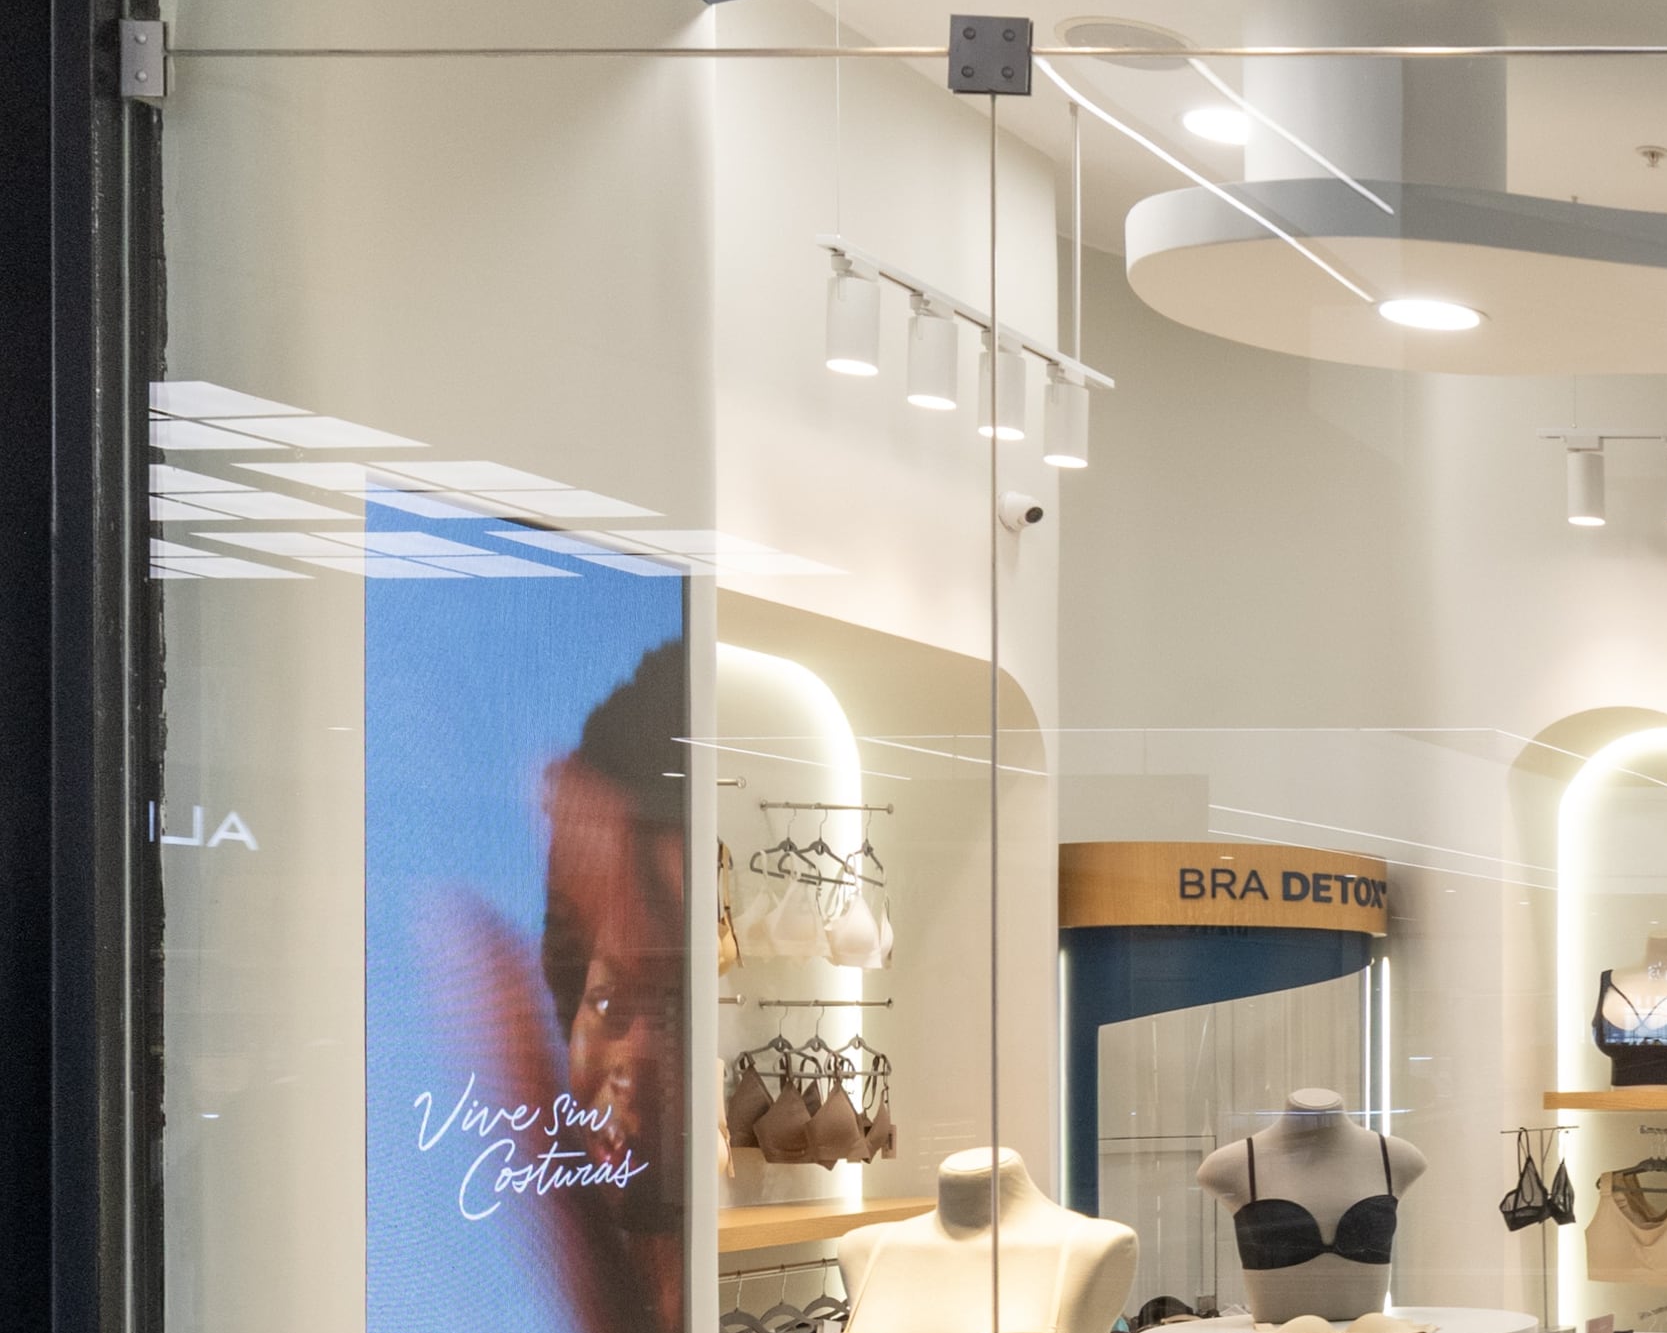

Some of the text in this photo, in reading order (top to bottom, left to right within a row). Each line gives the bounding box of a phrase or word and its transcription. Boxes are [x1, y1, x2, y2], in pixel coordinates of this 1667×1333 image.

[1179, 867, 1270, 901] BRA
[413, 1071, 541, 1152] Vive
[459, 1138, 650, 1221] Costuras
